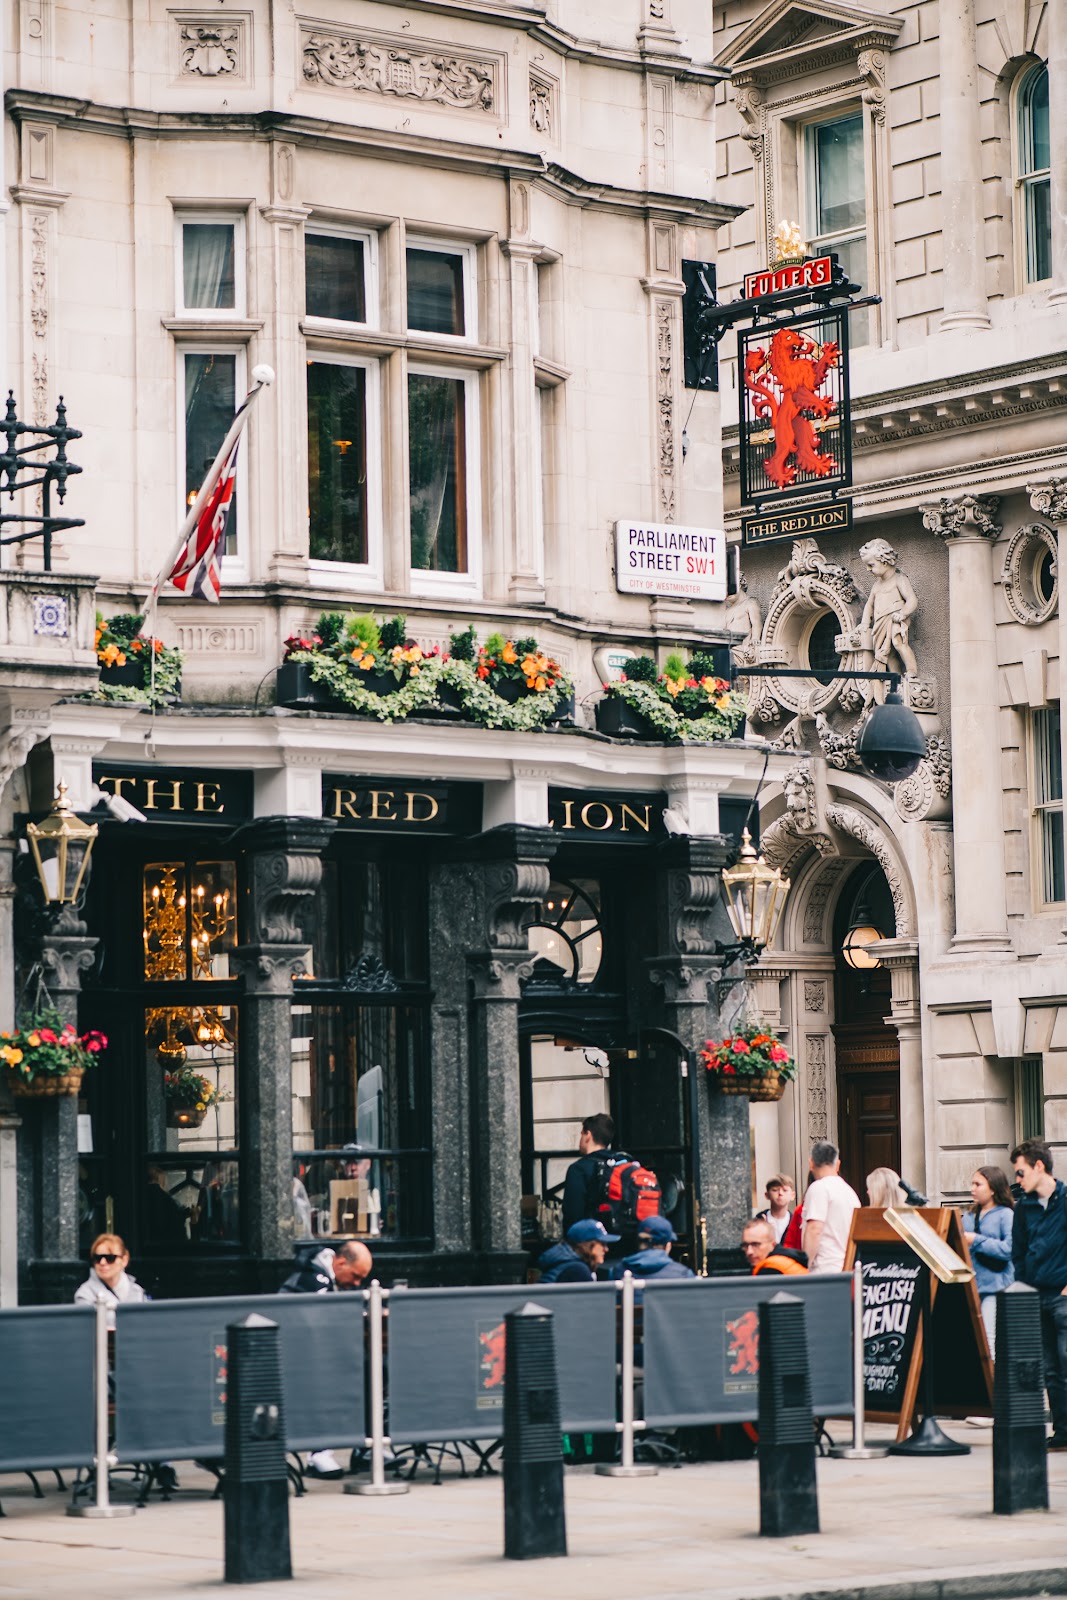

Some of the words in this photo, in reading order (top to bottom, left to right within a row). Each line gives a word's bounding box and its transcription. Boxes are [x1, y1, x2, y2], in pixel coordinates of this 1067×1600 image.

[748, 262, 825, 297] FULLER'S
[749, 523, 778, 538] THE
[780, 517, 808, 534] RED
[811, 510, 844, 529] LION
[629, 529, 716, 553] PARLIAMENT
[629, 551, 681, 571] STREET
[686, 557, 715, 575] SW1
[629, 579, 644, 588] CITY
[645, 581, 653, 589] OF
[656, 582, 701, 593] WESTMINSTER
[99, 775, 225, 814] THE
[333, 788, 439, 822] RED
[548, 800, 653, 834] ION
[862, 1262, 921, 1279] Traditional
[863, 1365, 896, 1378] UGHOUT
[867, 1377, 887, 1391] DAY
